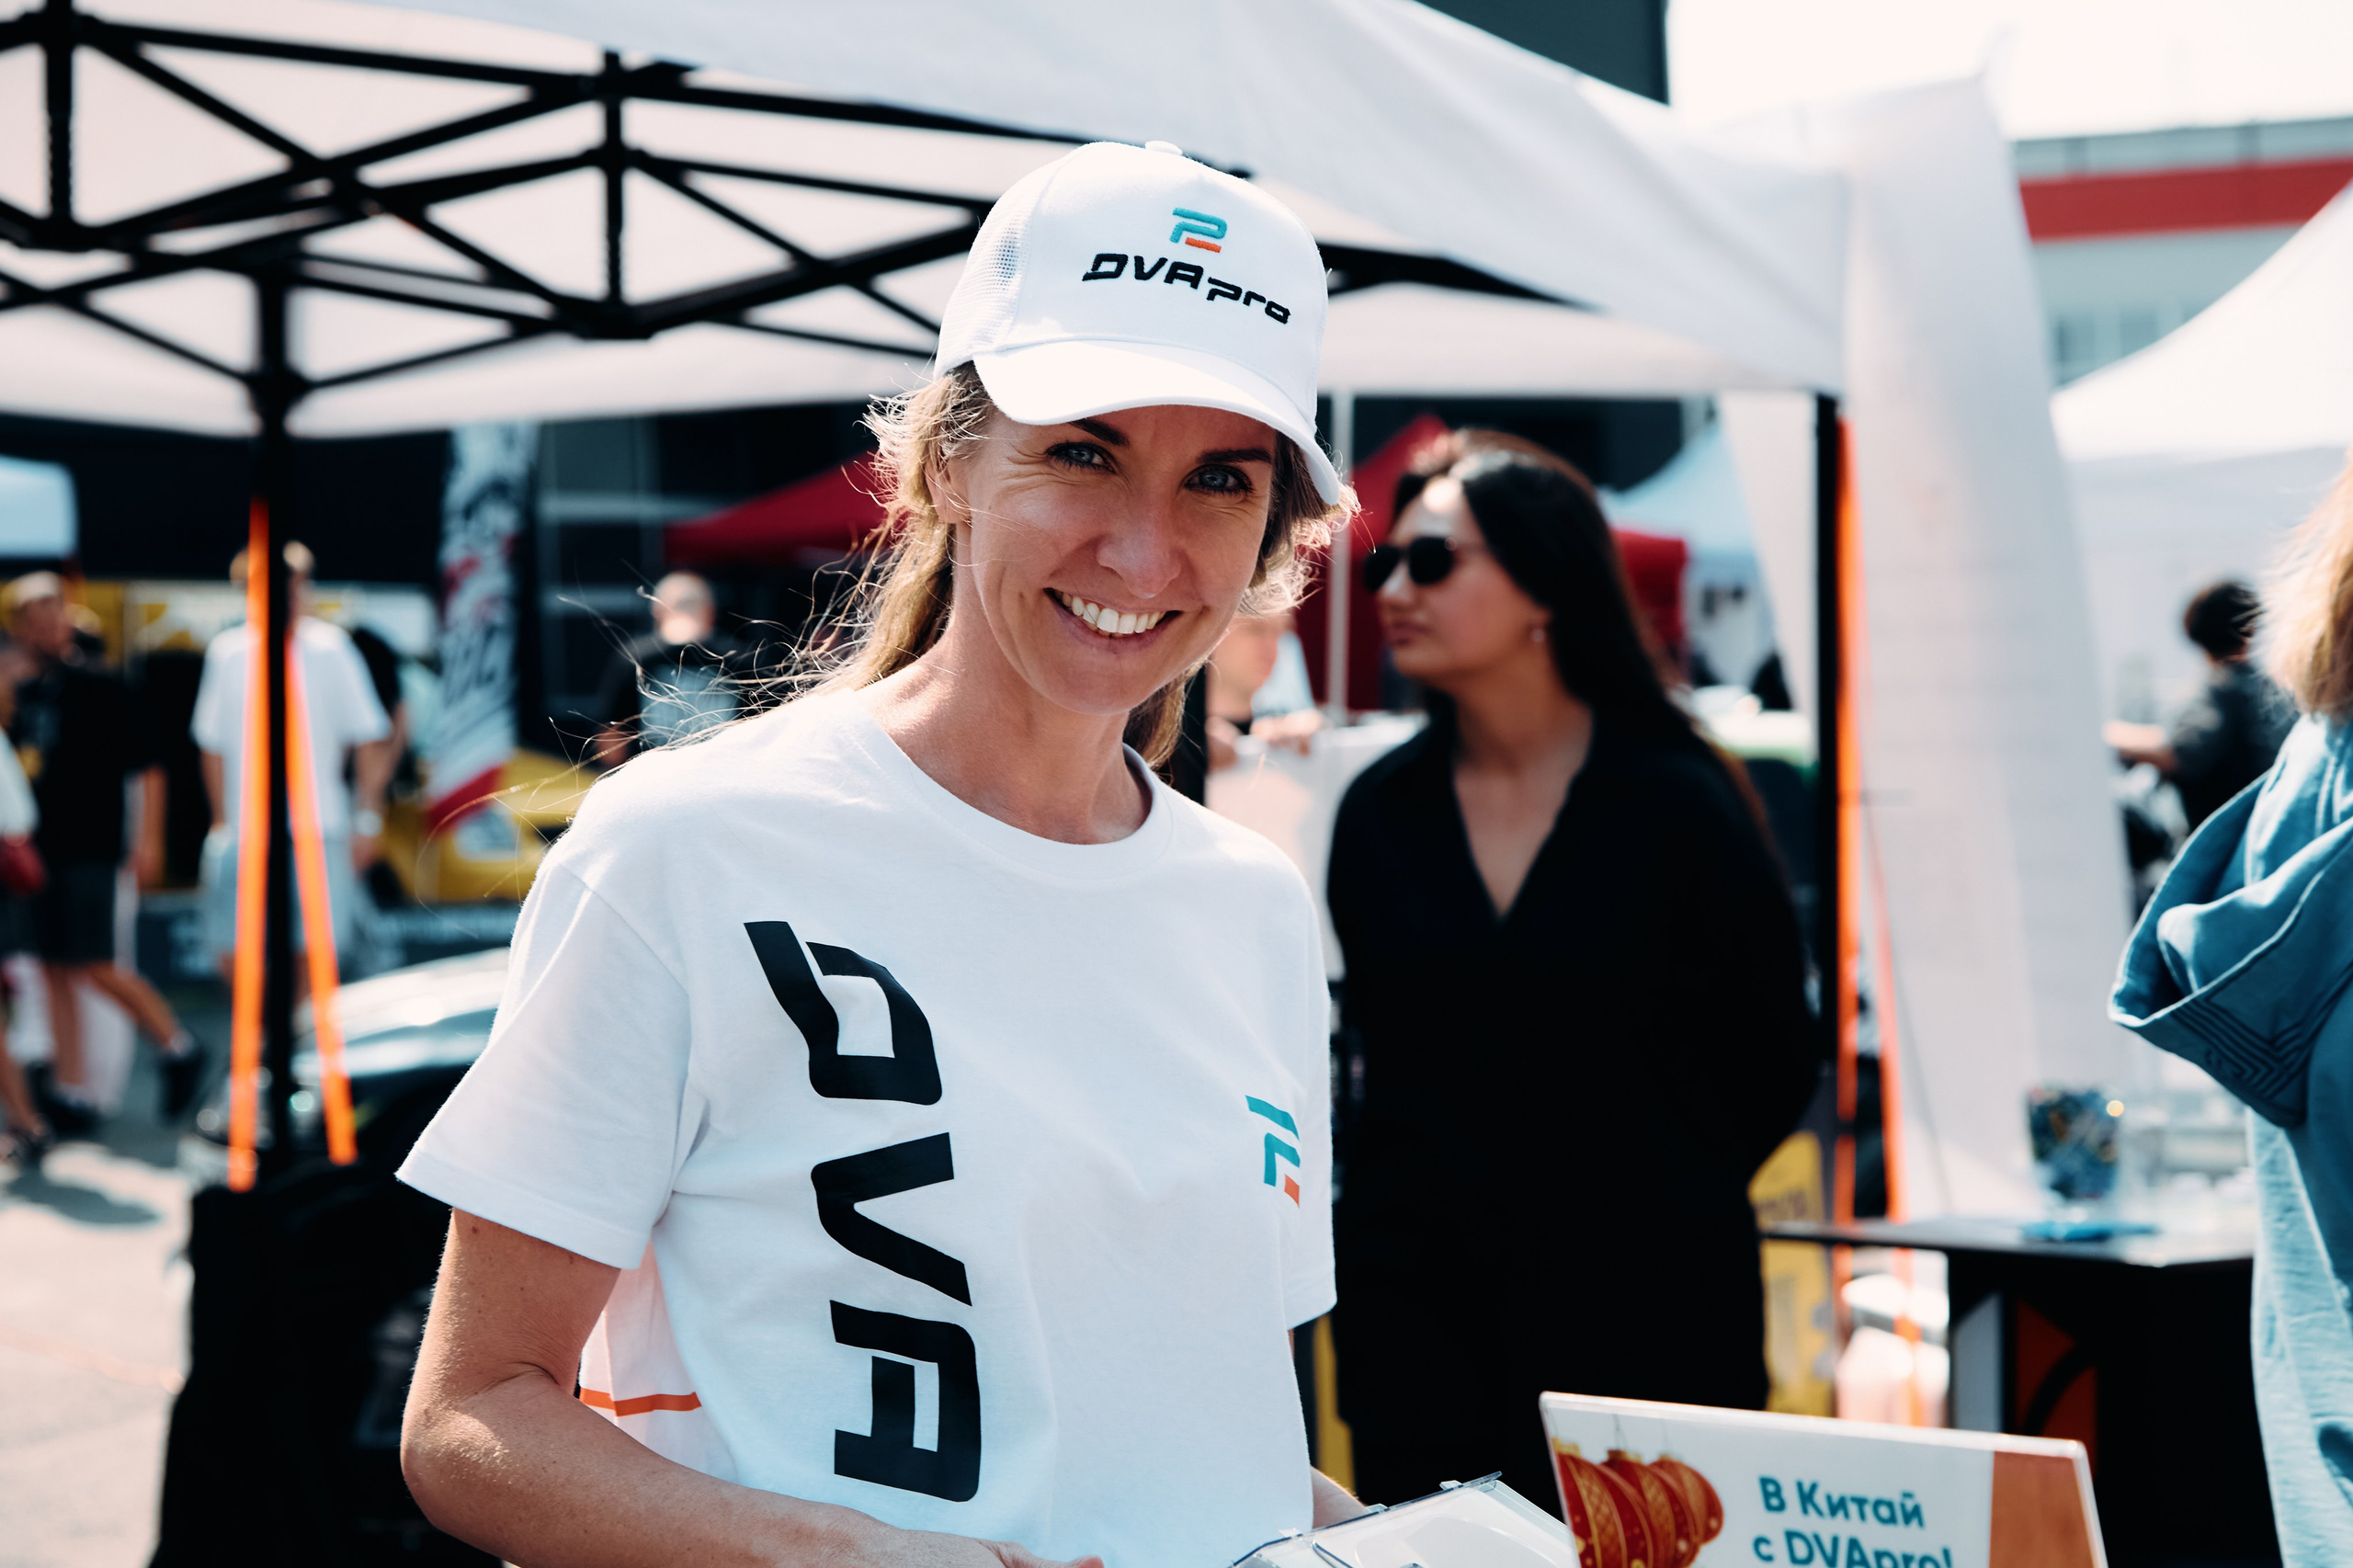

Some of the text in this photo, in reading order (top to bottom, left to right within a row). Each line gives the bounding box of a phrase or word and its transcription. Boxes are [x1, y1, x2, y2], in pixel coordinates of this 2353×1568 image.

[743, 920, 982, 1502] DVA
[1757, 1475, 1925, 1528] В Китай
[1752, 1535, 1776, 1562] с
